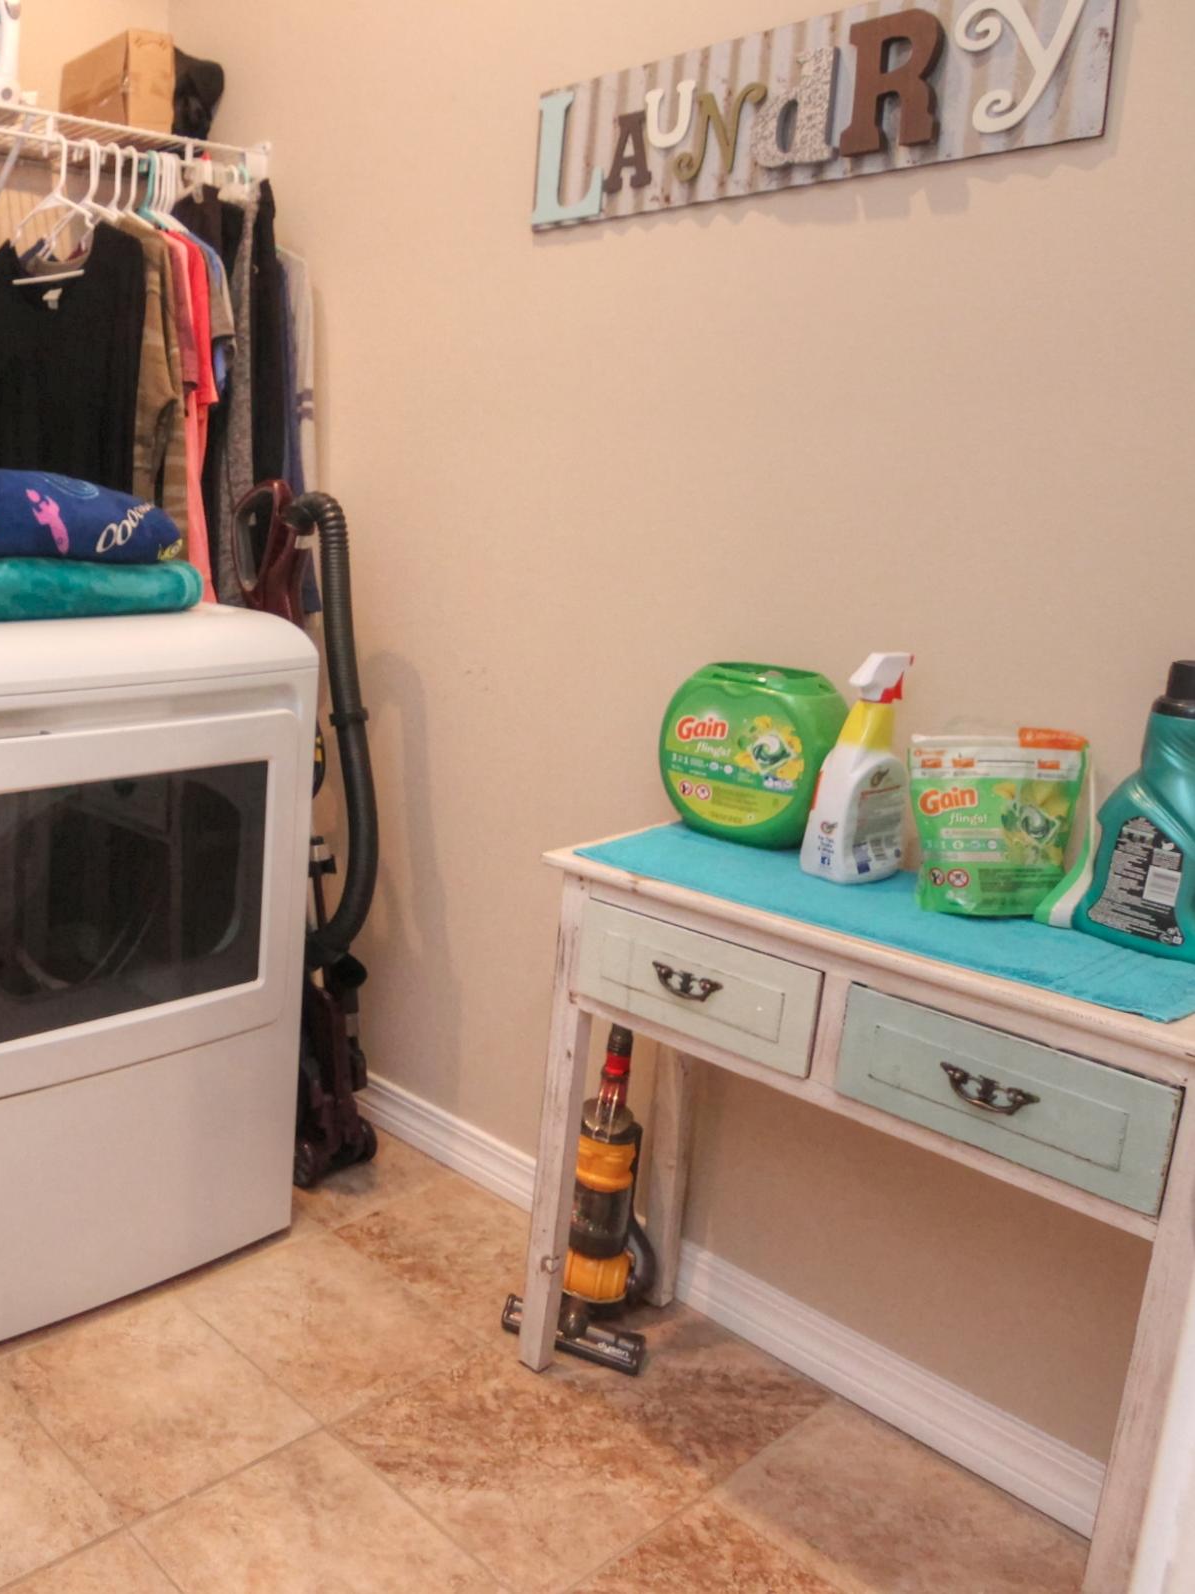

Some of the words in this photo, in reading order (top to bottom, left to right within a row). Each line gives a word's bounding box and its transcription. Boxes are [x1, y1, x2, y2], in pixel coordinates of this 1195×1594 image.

[677, 716, 728, 742] Gain
[919, 786, 978, 816] Gain
[948, 812, 989, 826] flings!
[598, 1342, 629, 1357] dyson
